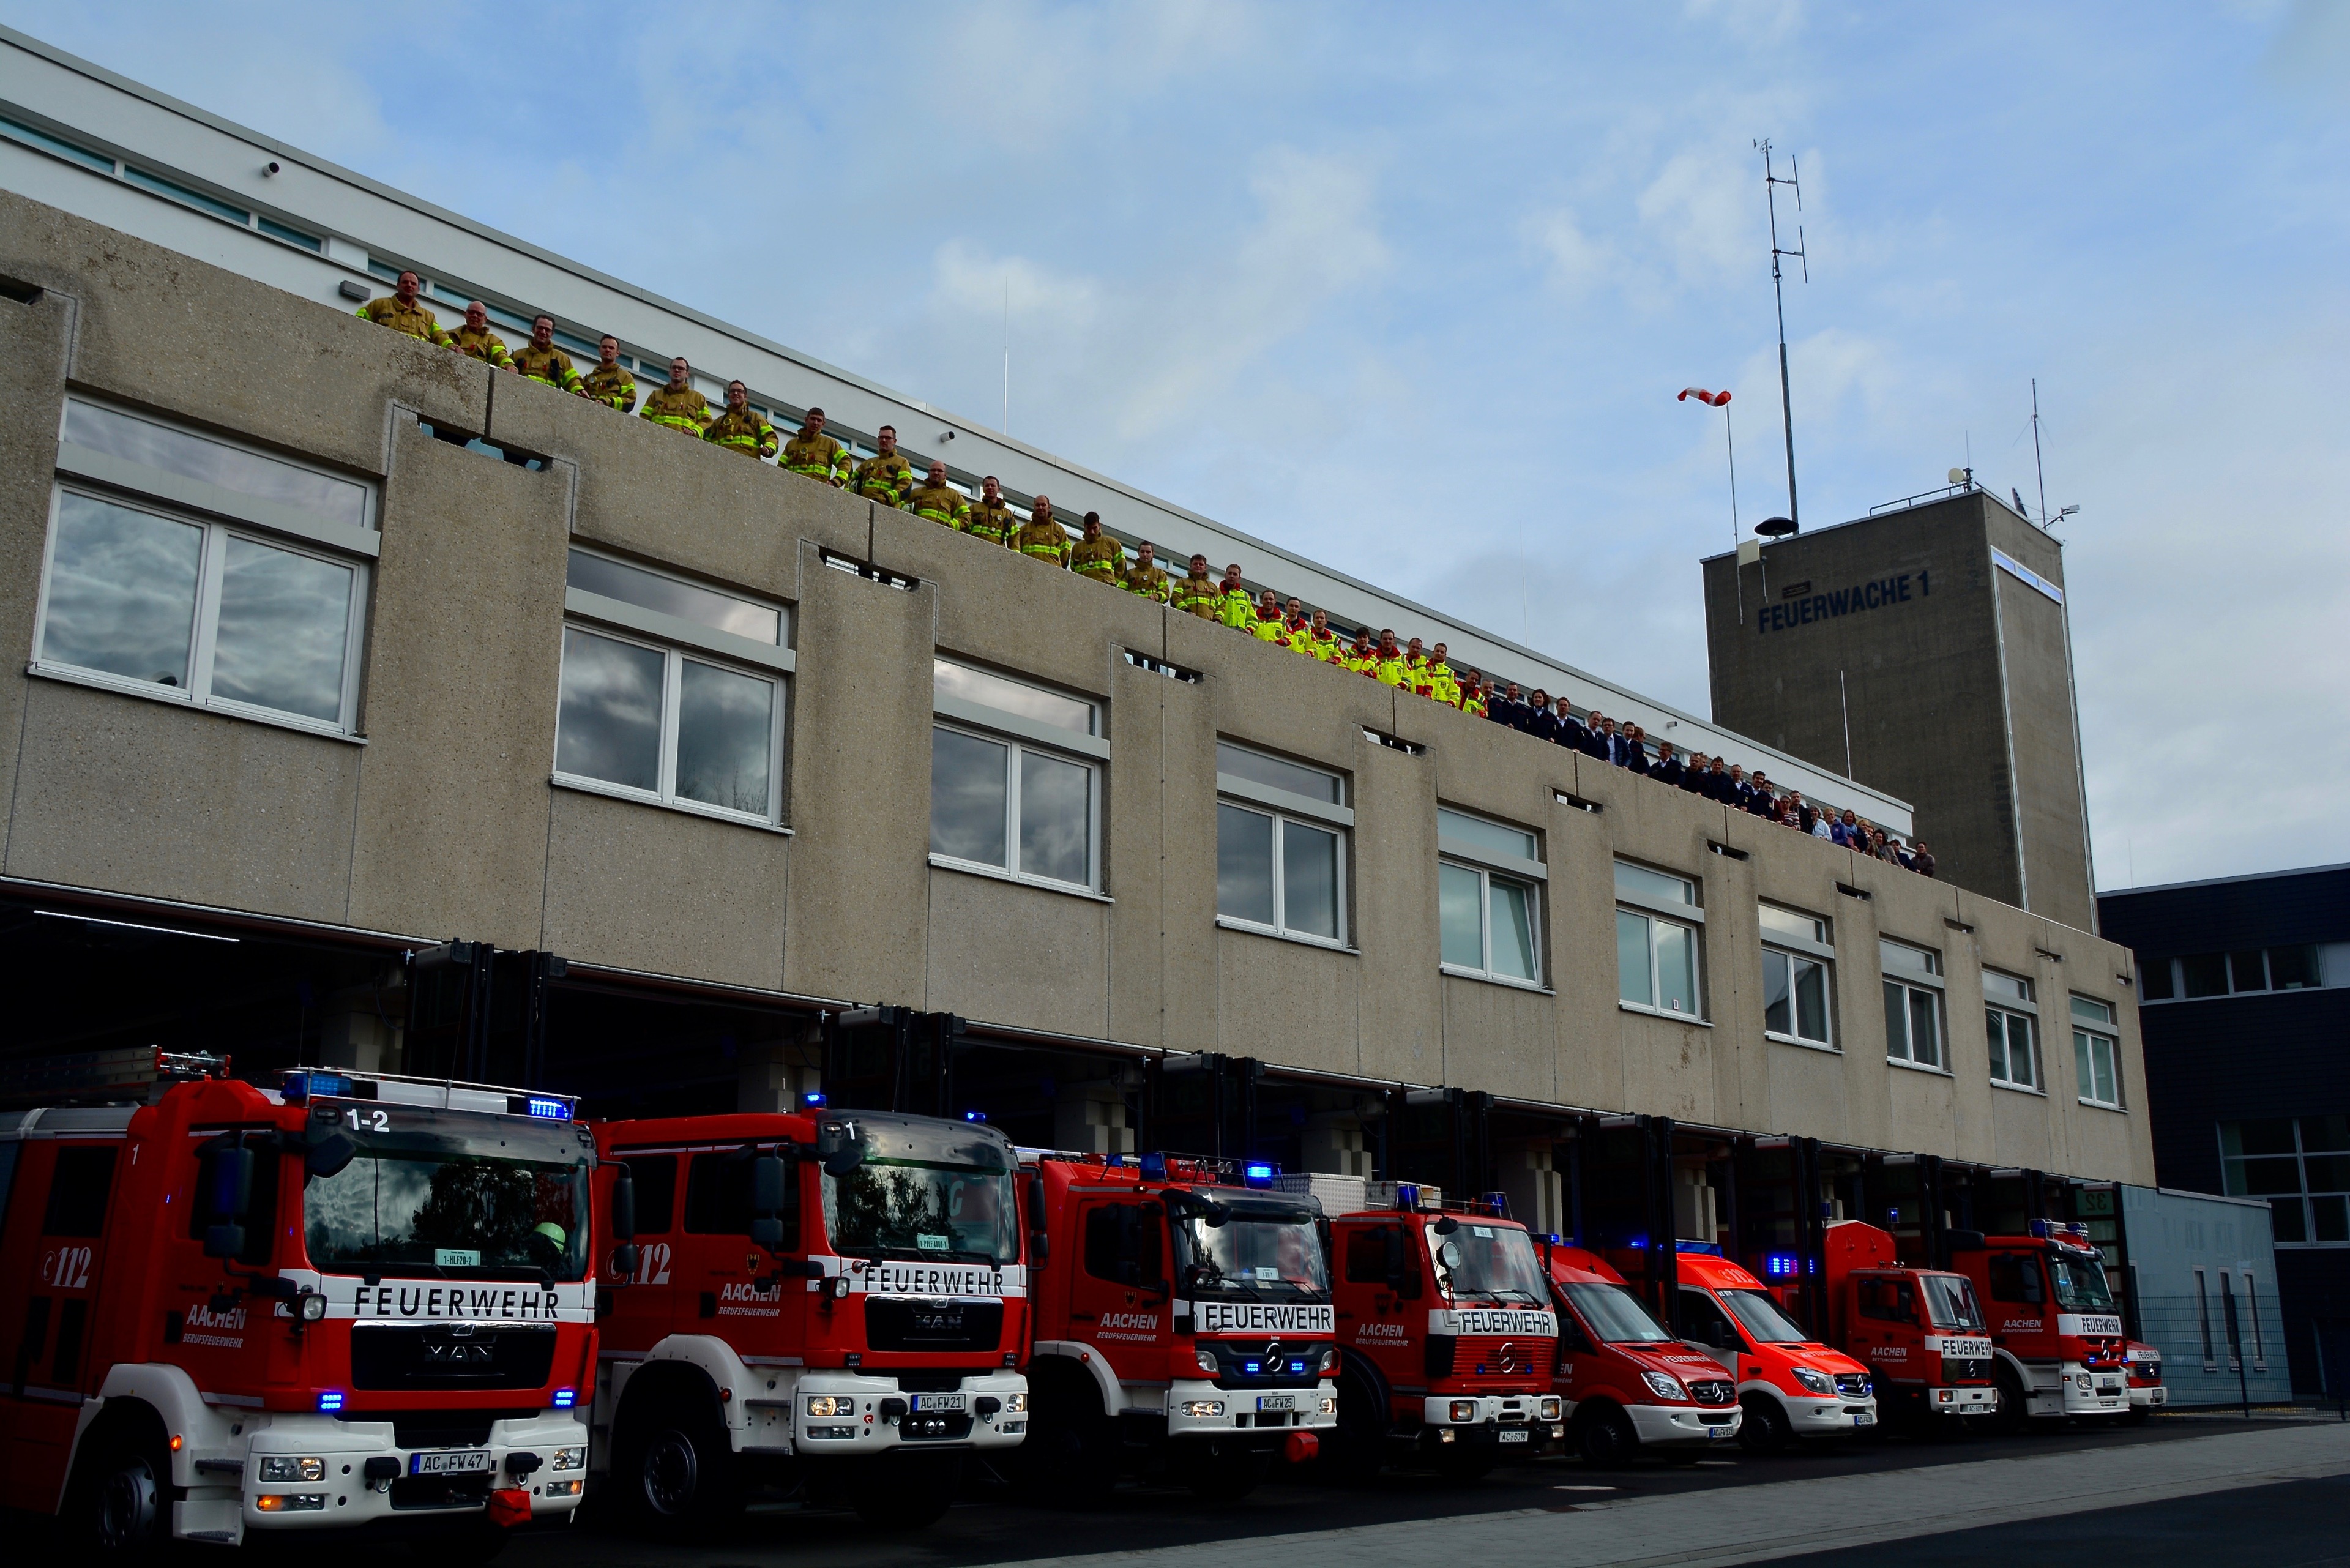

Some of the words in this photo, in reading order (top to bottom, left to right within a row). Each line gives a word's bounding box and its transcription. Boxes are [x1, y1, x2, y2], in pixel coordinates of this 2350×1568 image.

[1758, 575, 1911, 633] FEUERWACHE
[1918, 570, 1928, 596] 1
[346, 1109, 389, 1132] 1-2
[845, 1122, 855, 1140] 1
[133, 1143, 140, 1165] 1
[51, 1247, 91, 1288] 112
[444, 1255, 472, 1265] 1-HLF20-2
[864, 1269, 1004, 1295] FEUERWEHR
[720, 1283, 781, 1302] AACHEN
[354, 1287, 559, 1318] FEUERWEHR
[185, 1304, 247, 1330] AACHEN
[718, 1307, 780, 1317] BERUFSFEUERWEHR
[1205, 1305, 1331, 1329] FEUERWEHR
[915, 1315, 962, 1330] MAN
[1100, 1313, 1158, 1330] AACHEN
[1461, 1312, 1550, 1334] FEUERWEHR
[2003, 1320, 2042, 1328] AACHEN
[2081, 1318, 2119, 1333] FEUERWEHR
[1097, 1332, 1157, 1342] BERUFSFEUERWEHR
[1358, 1323, 1404, 1337] AACHEN
[182, 1333, 244, 1348] BERUFSFEUERWEHR
[1355, 1338, 1408, 1346] BERUFSFEUERWEHR
[1941, 1340, 1991, 1356] FEUERWEHR
[424, 1346, 493, 1362] MAN
[1871, 1347, 1907, 1357] AACHEN
[920, 1397, 932, 1409] AC
[938, 1397, 949, 1408] FW
[950, 1397, 961, 1408] 21
[1264, 1398, 1272, 1408] AC
[1285, 1398, 1292, 1407] 25
[1502, 1432, 1510, 1441] AC
[423, 1456, 440, 1471] AC
[449, 1455, 466, 1469] FW
[468, 1454, 483, 1468] 47
